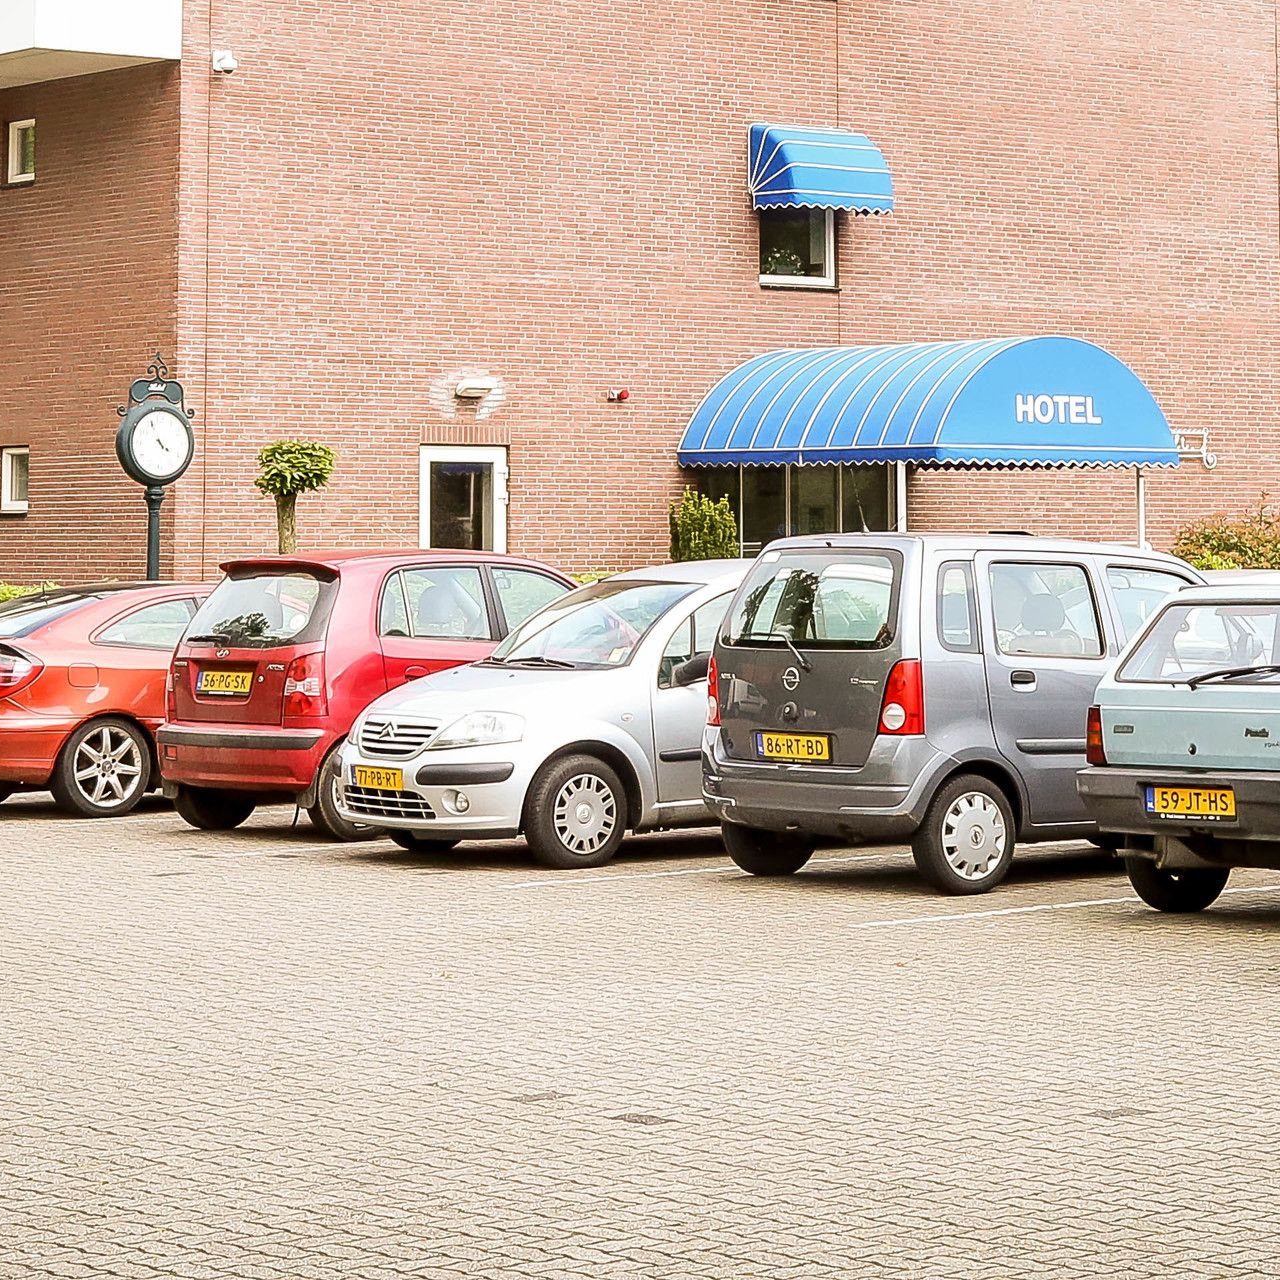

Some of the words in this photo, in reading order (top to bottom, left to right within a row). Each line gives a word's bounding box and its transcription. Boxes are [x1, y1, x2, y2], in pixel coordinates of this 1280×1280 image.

[1016, 394, 1103, 424] HOTEL
[204, 674, 247, 689] 56-PG-SK
[766, 737, 824, 756] 86-RT-BD
[358, 769, 397, 787] 77-PB-RT
[1161, 791, 1229, 811] 59-JT-HS
